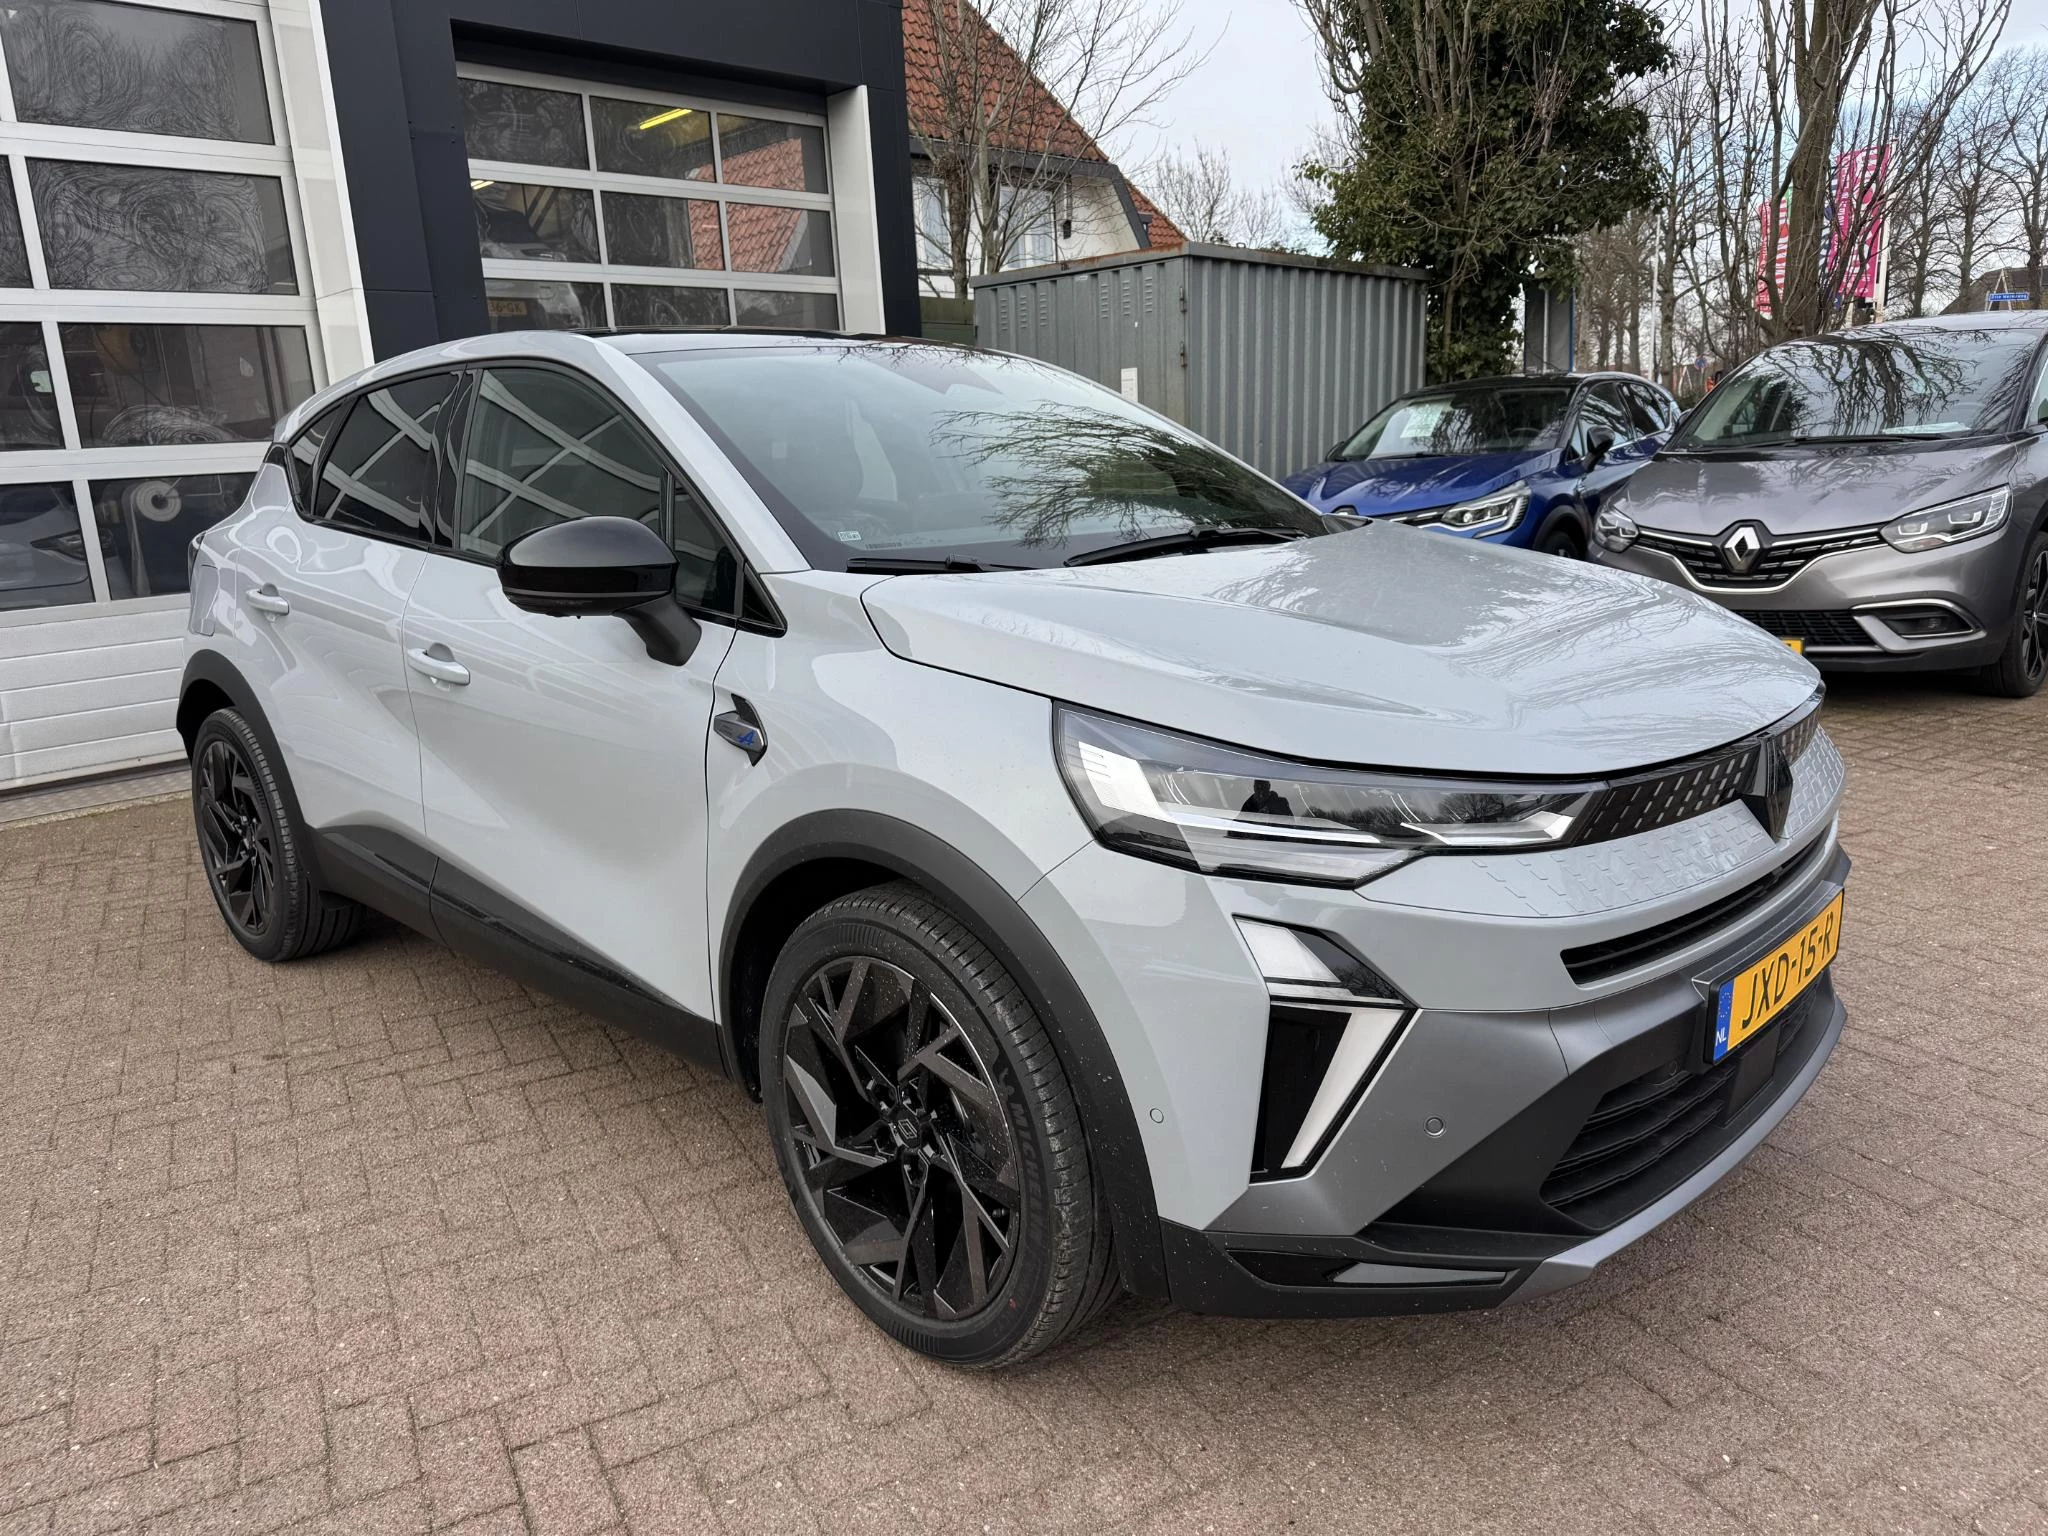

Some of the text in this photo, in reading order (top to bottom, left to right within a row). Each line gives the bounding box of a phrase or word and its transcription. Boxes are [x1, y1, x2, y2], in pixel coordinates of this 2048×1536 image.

[1741, 911, 1834, 1030] JXD-15-R
[1715, 1027, 1727, 1046] NL
[1009, 1102, 1043, 1241] MICHELIN
